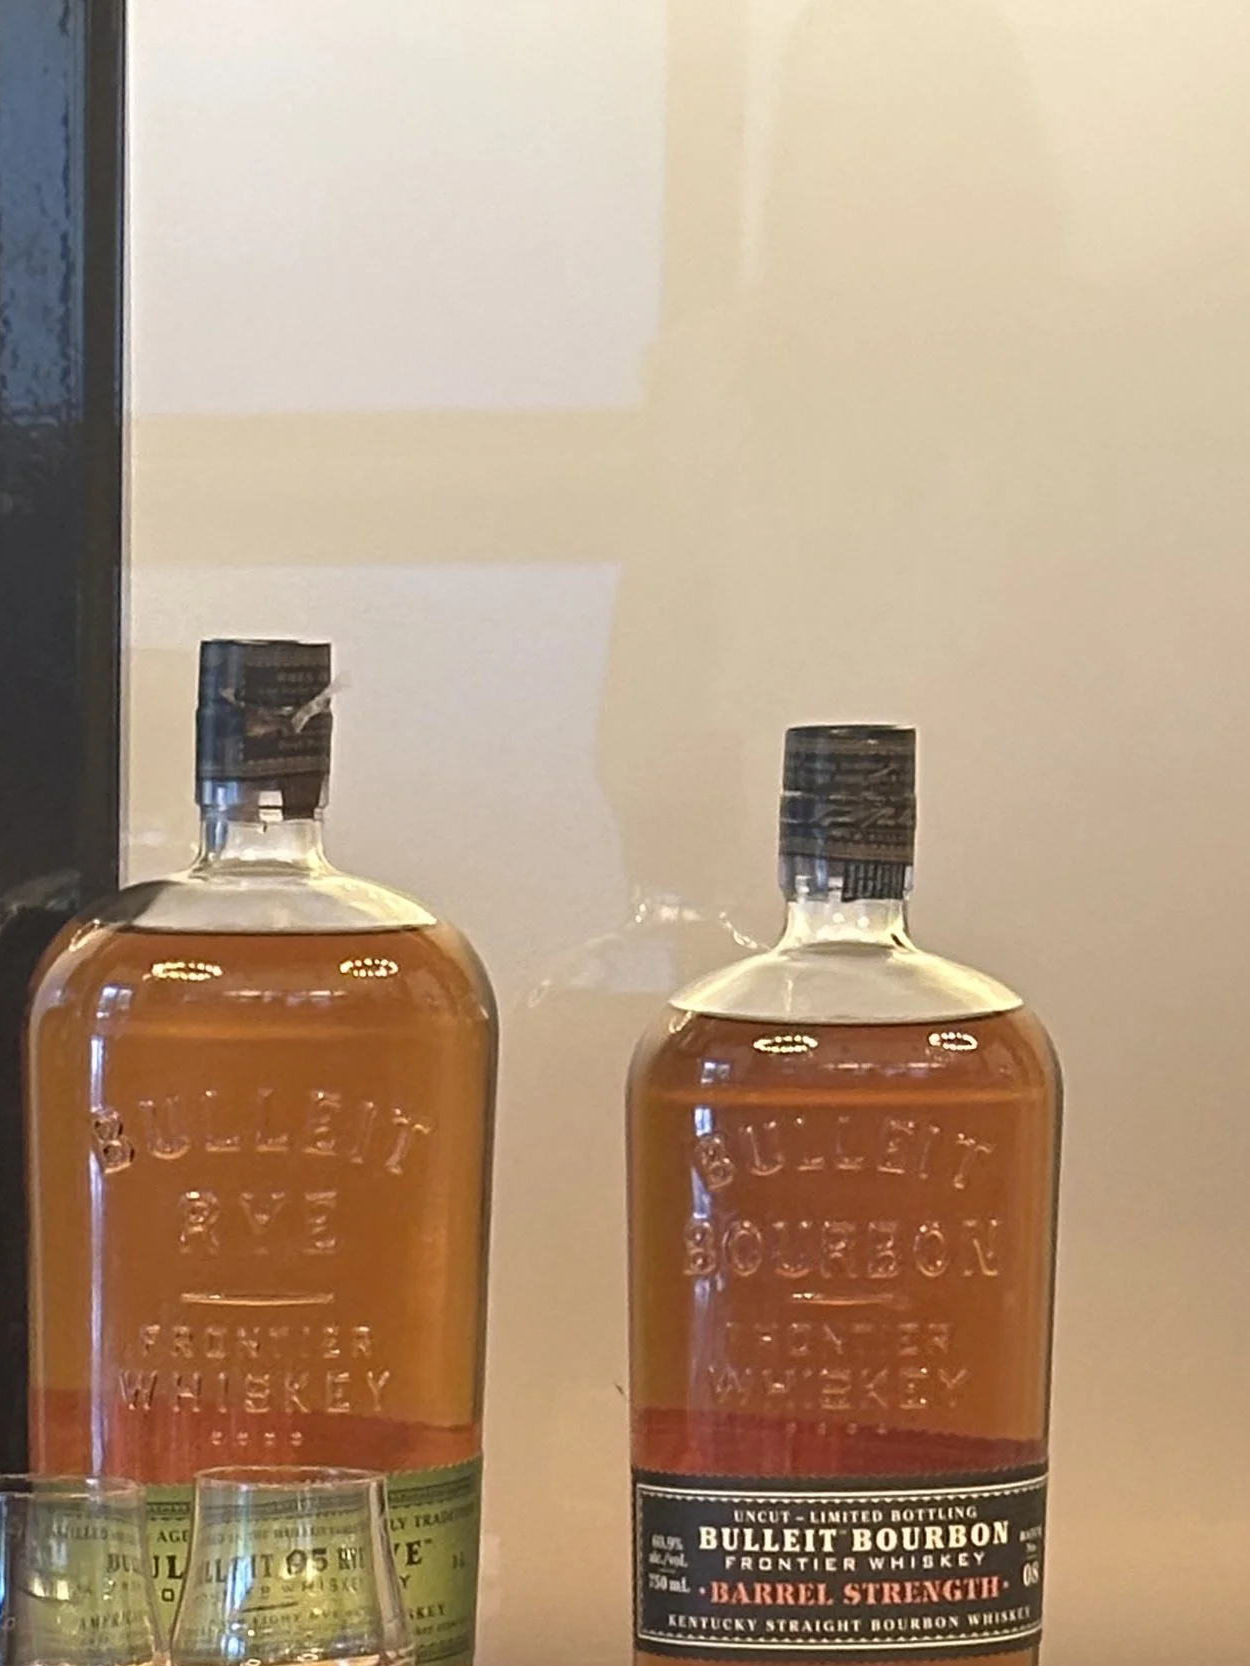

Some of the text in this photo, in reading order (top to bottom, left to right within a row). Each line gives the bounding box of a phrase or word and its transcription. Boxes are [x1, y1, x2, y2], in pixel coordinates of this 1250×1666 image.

[90, 1088, 434, 1174] BULLEIT
[695, 1116, 997, 1190] BULLEIT
[178, 1190, 339, 1255] RYE
[683, 1220, 1002, 1278] BOURBON
[138, 1324, 374, 1359] FRONTIER
[117, 1370, 392, 1414] WHISKEY
[708, 1366, 970, 1411] WHISKEY
[734, 1506, 978, 1524] UNCUT LIMITED BOTTLING
[852, 1520, 1009, 1552] BOURBON
[725, 1551, 986, 1572] FRONTIER WHISKEY
[710, 1575, 1000, 1606] BARREL STRENGTH
[668, 1606, 1032, 1633] KENTUCKY STRAIGHT BOURBON WHISKEY
